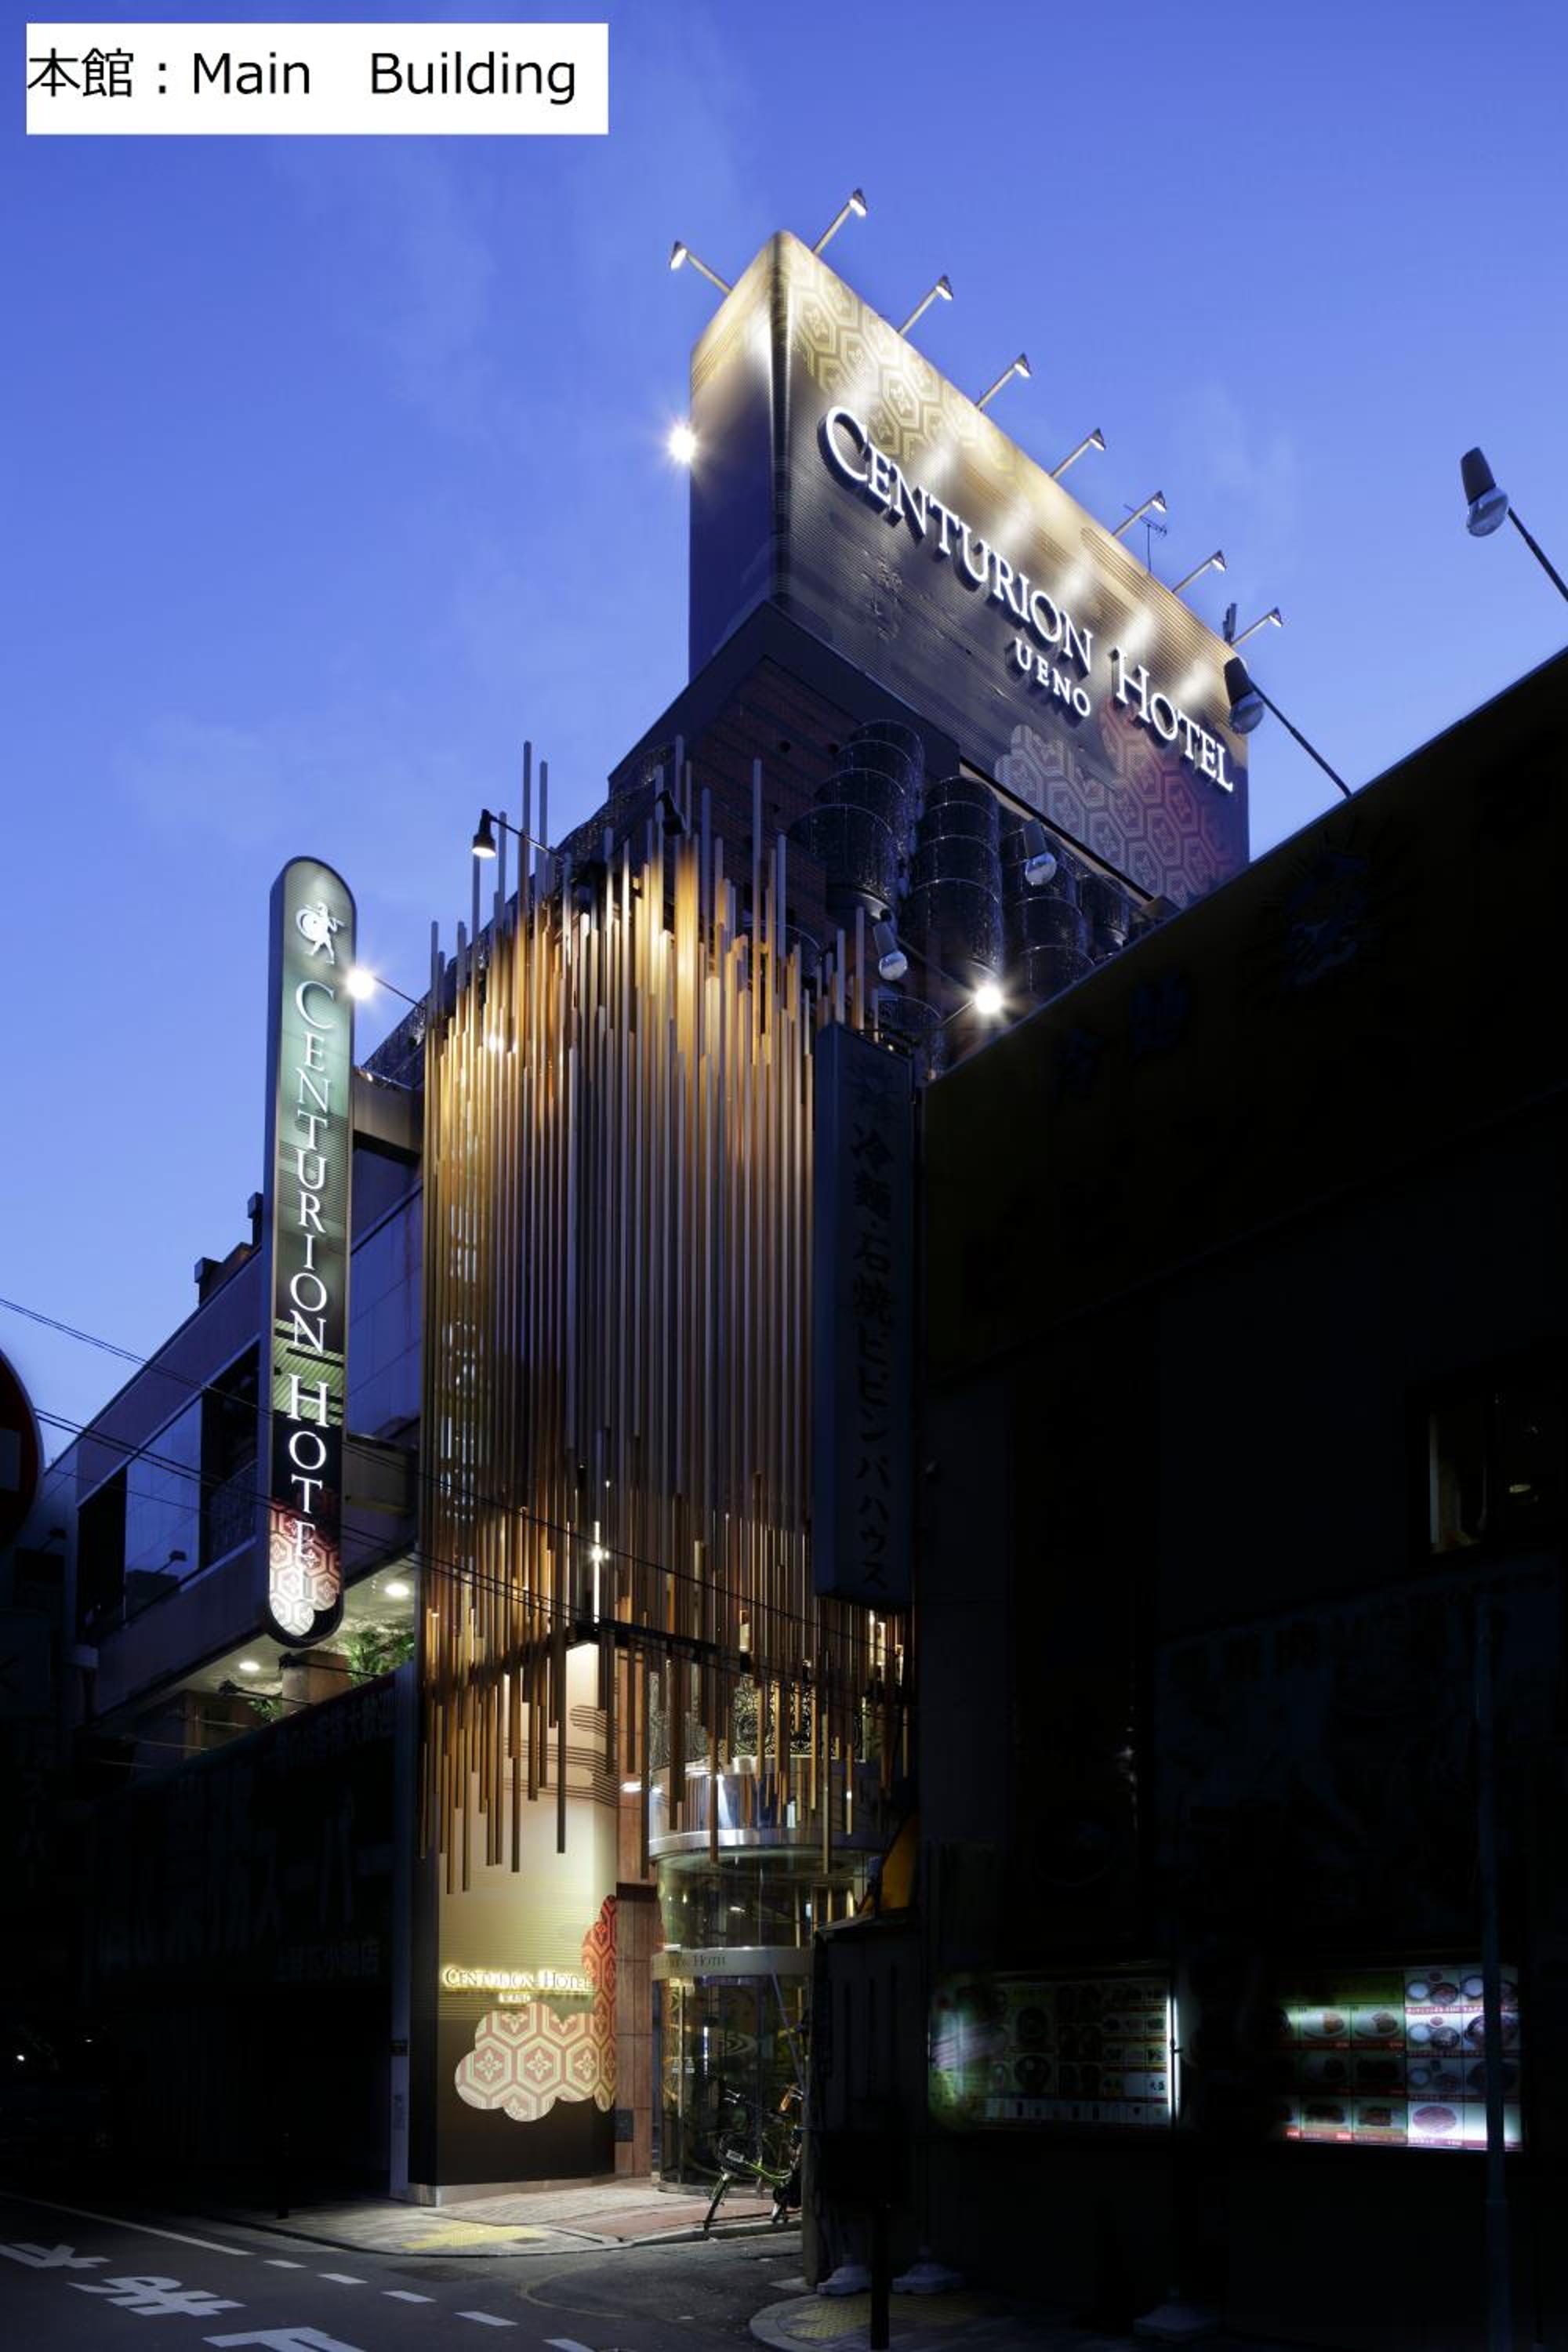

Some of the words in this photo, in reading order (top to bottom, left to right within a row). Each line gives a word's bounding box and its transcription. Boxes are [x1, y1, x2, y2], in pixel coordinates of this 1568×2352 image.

[822, 405, 1094, 677] CENTURION
[1113, 648, 1234, 793] HOTEL
[1014, 637, 1091, 717] UENO
[289, 980, 336, 1355] CENTURION
